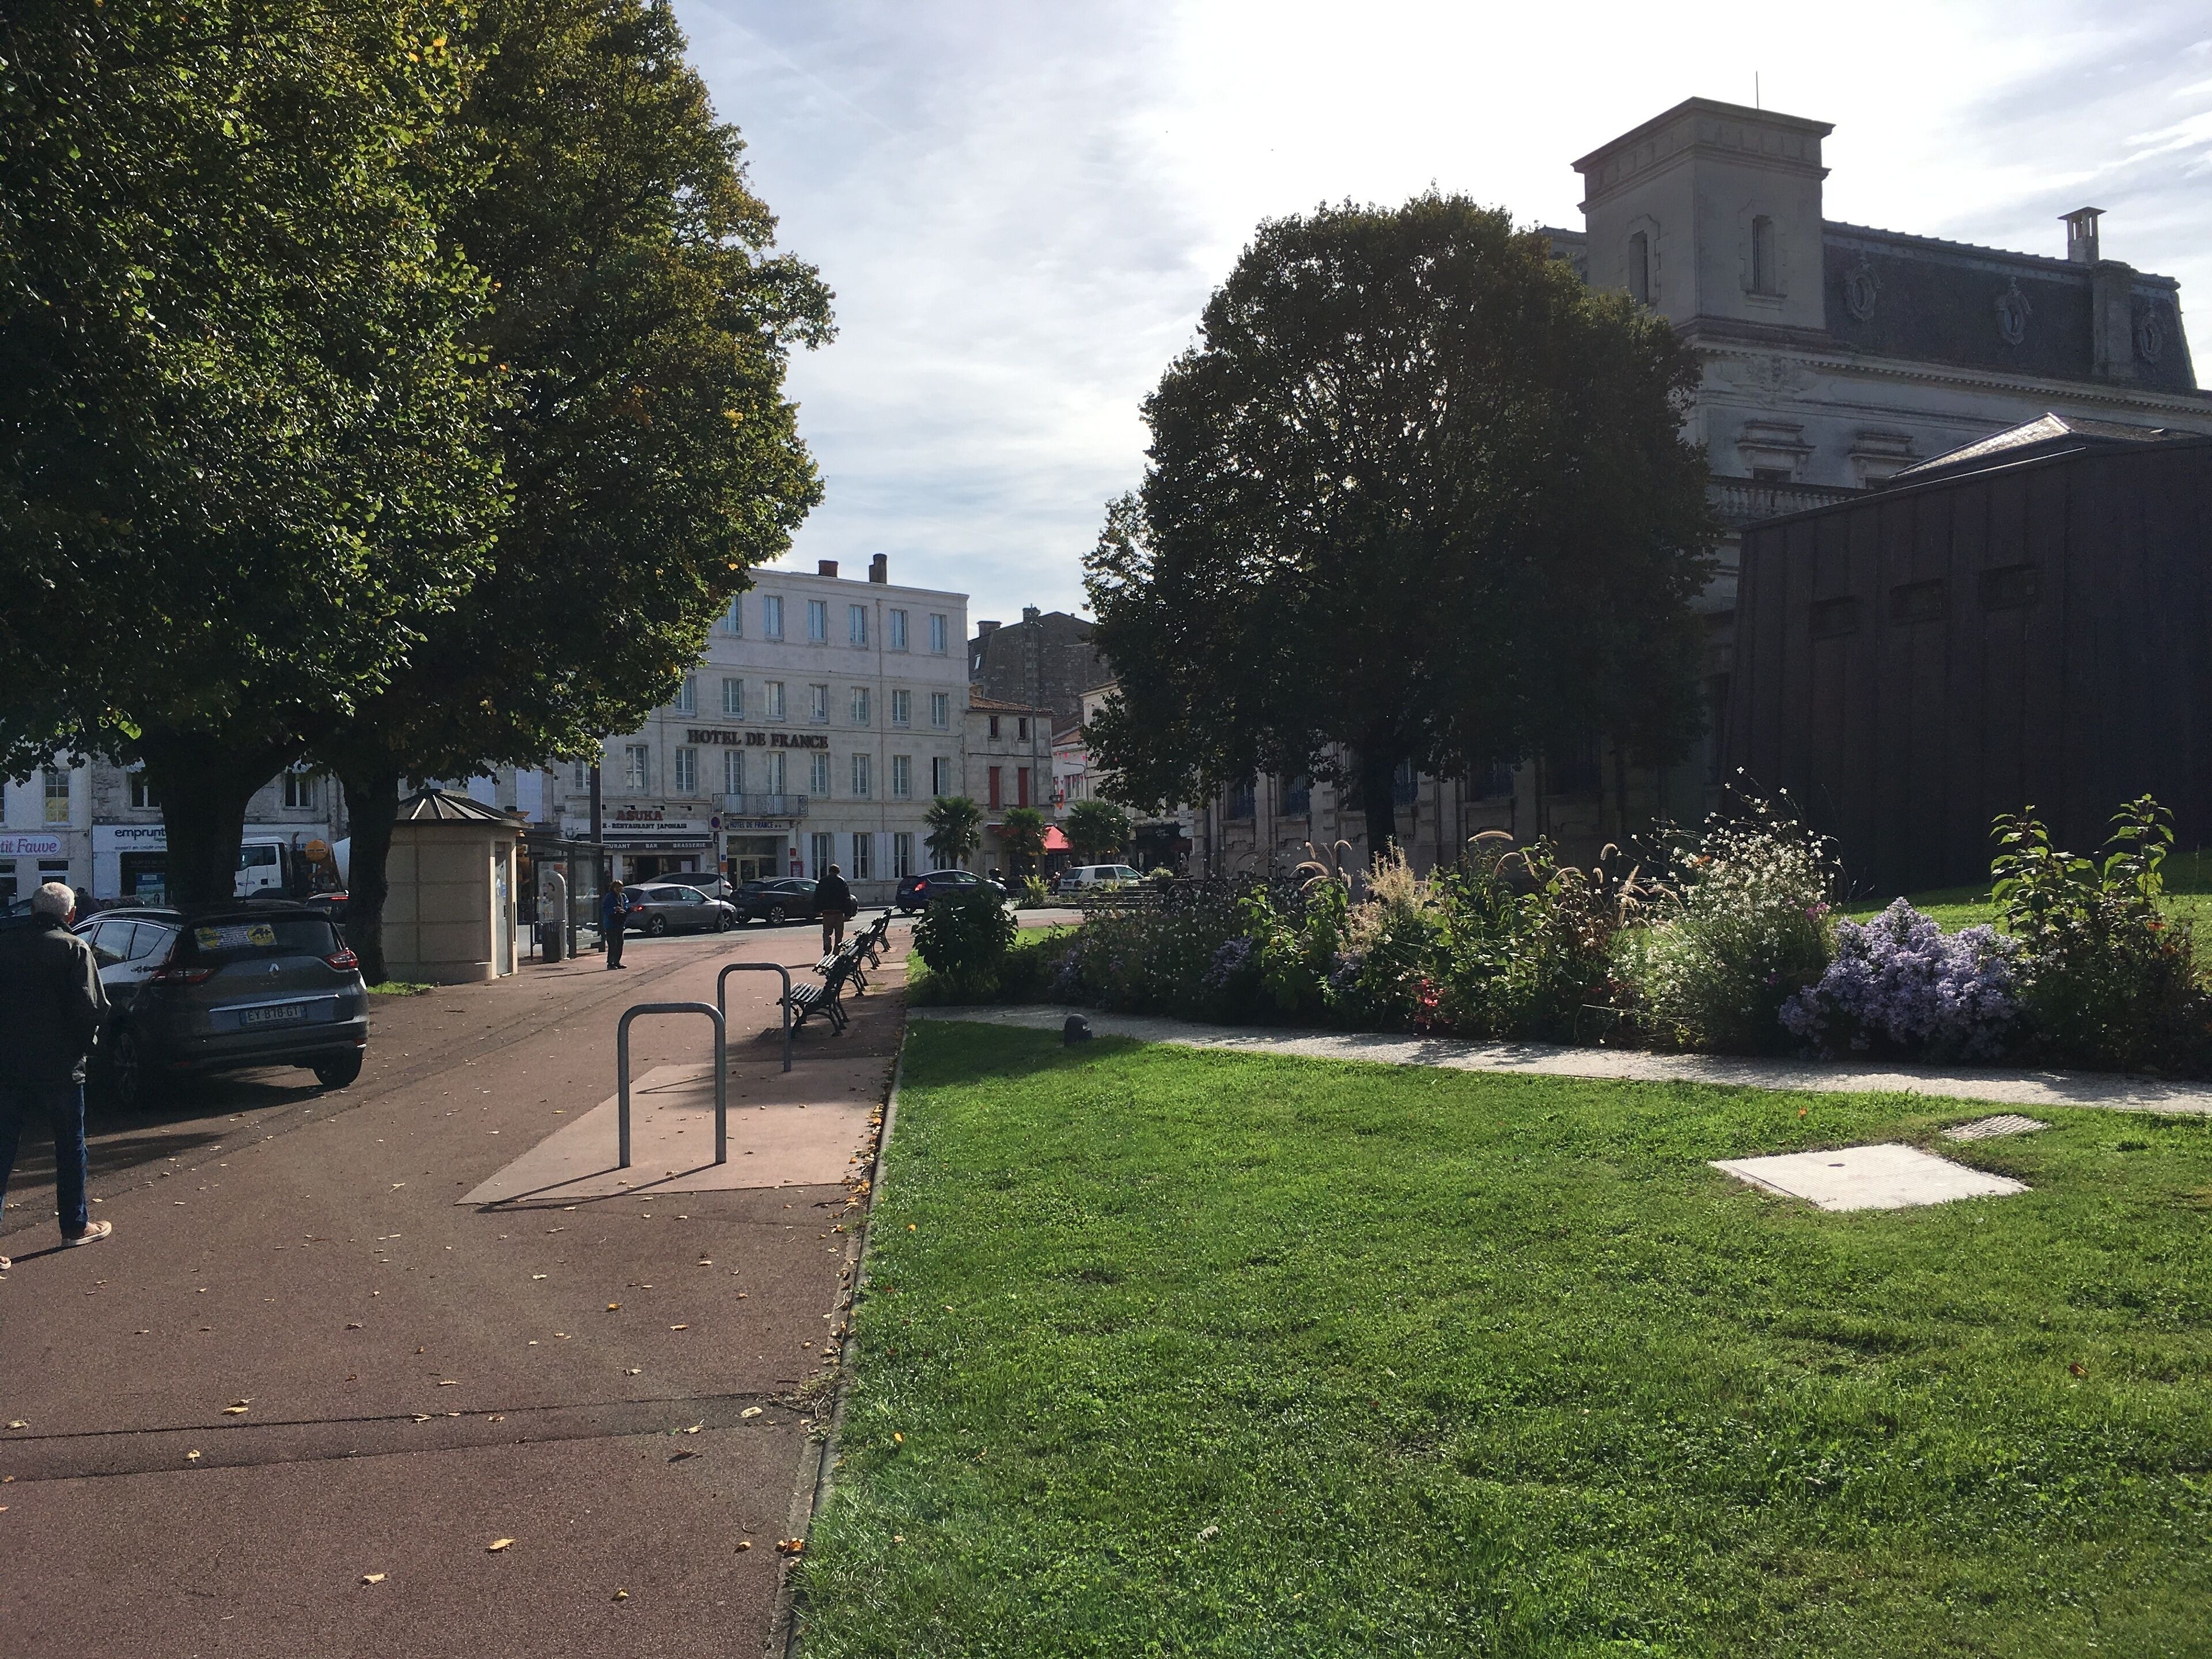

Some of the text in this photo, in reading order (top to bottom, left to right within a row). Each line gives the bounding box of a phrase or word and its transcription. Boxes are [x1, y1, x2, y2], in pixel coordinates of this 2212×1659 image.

[687, 729, 829, 748] HOTEL DE FRANCE
[616, 810, 664, 821] ASUKA
[16, 839, 56, 853] Fauve
